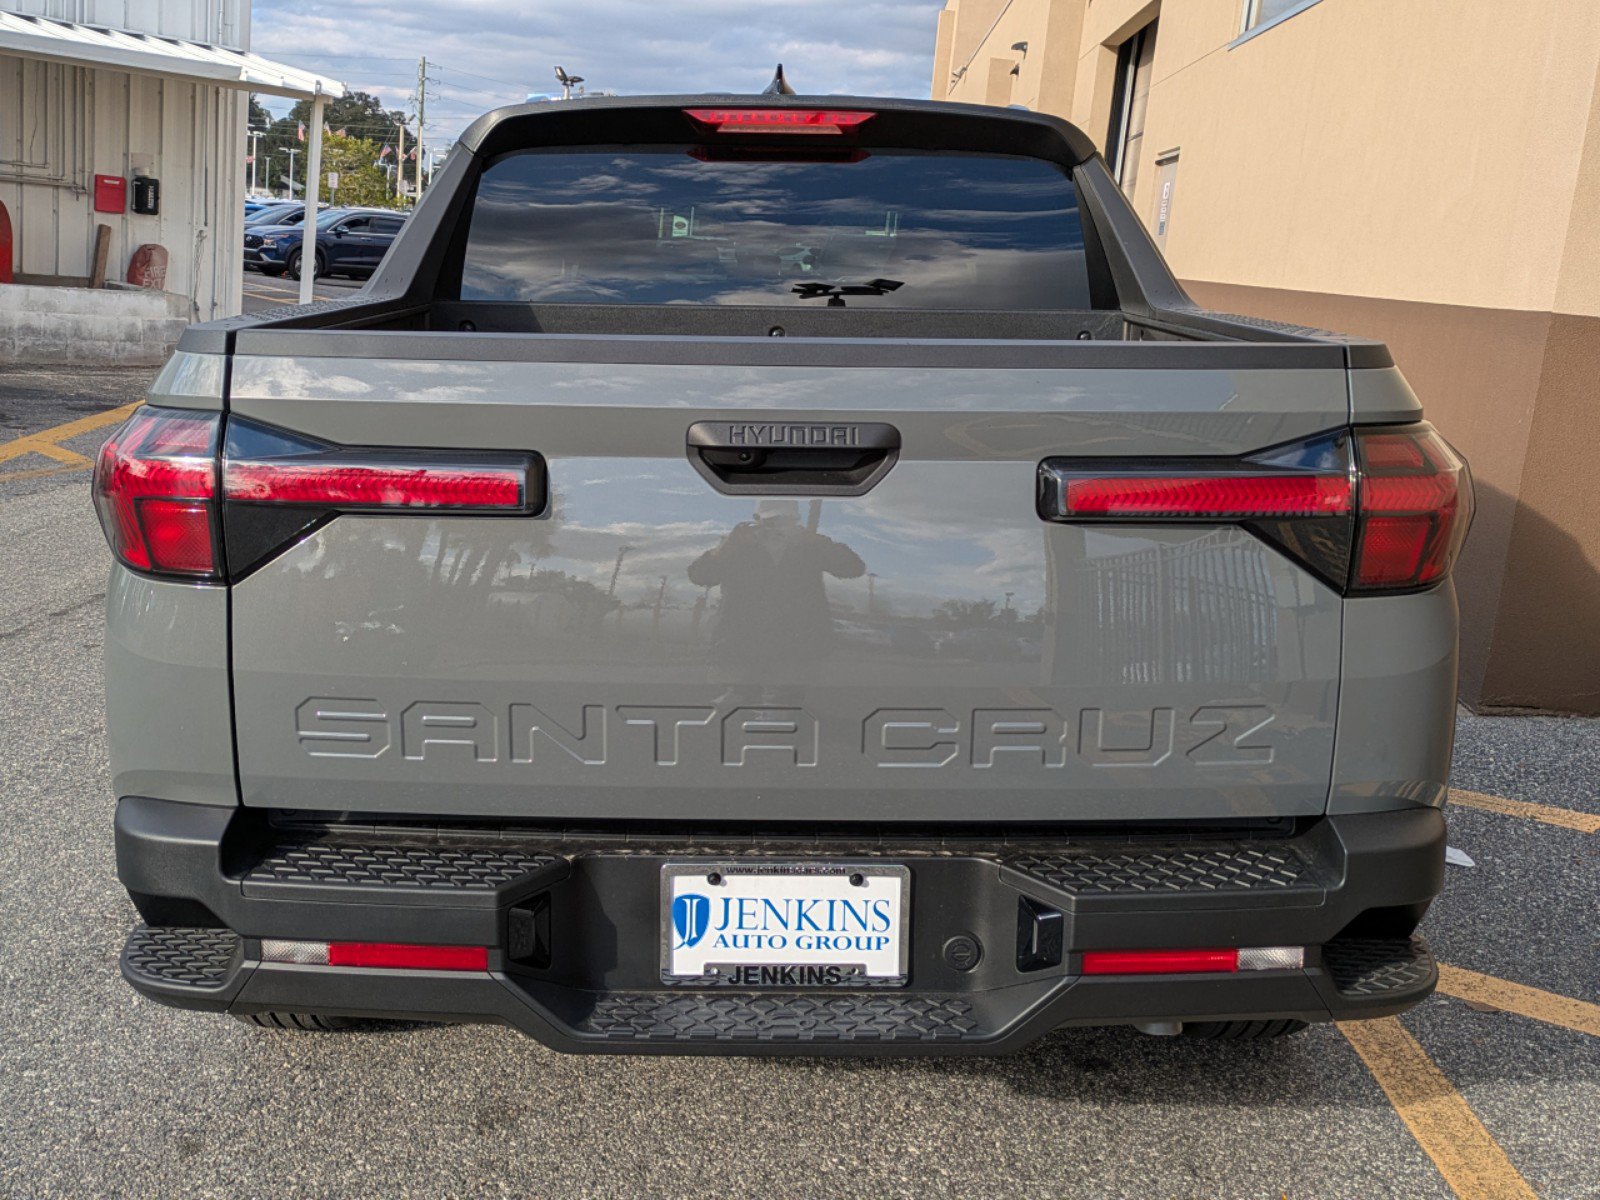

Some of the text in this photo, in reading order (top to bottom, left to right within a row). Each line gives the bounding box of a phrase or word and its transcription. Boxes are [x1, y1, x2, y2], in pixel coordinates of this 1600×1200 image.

[729, 425, 859, 445] HYUNDAI
[295, 696, 1276, 768] SANTA CRUZ
[714, 897, 891, 932] JENKINS
[712, 934, 890, 950] AUTO GROUP
[728, 966, 842, 985] JENKINS
